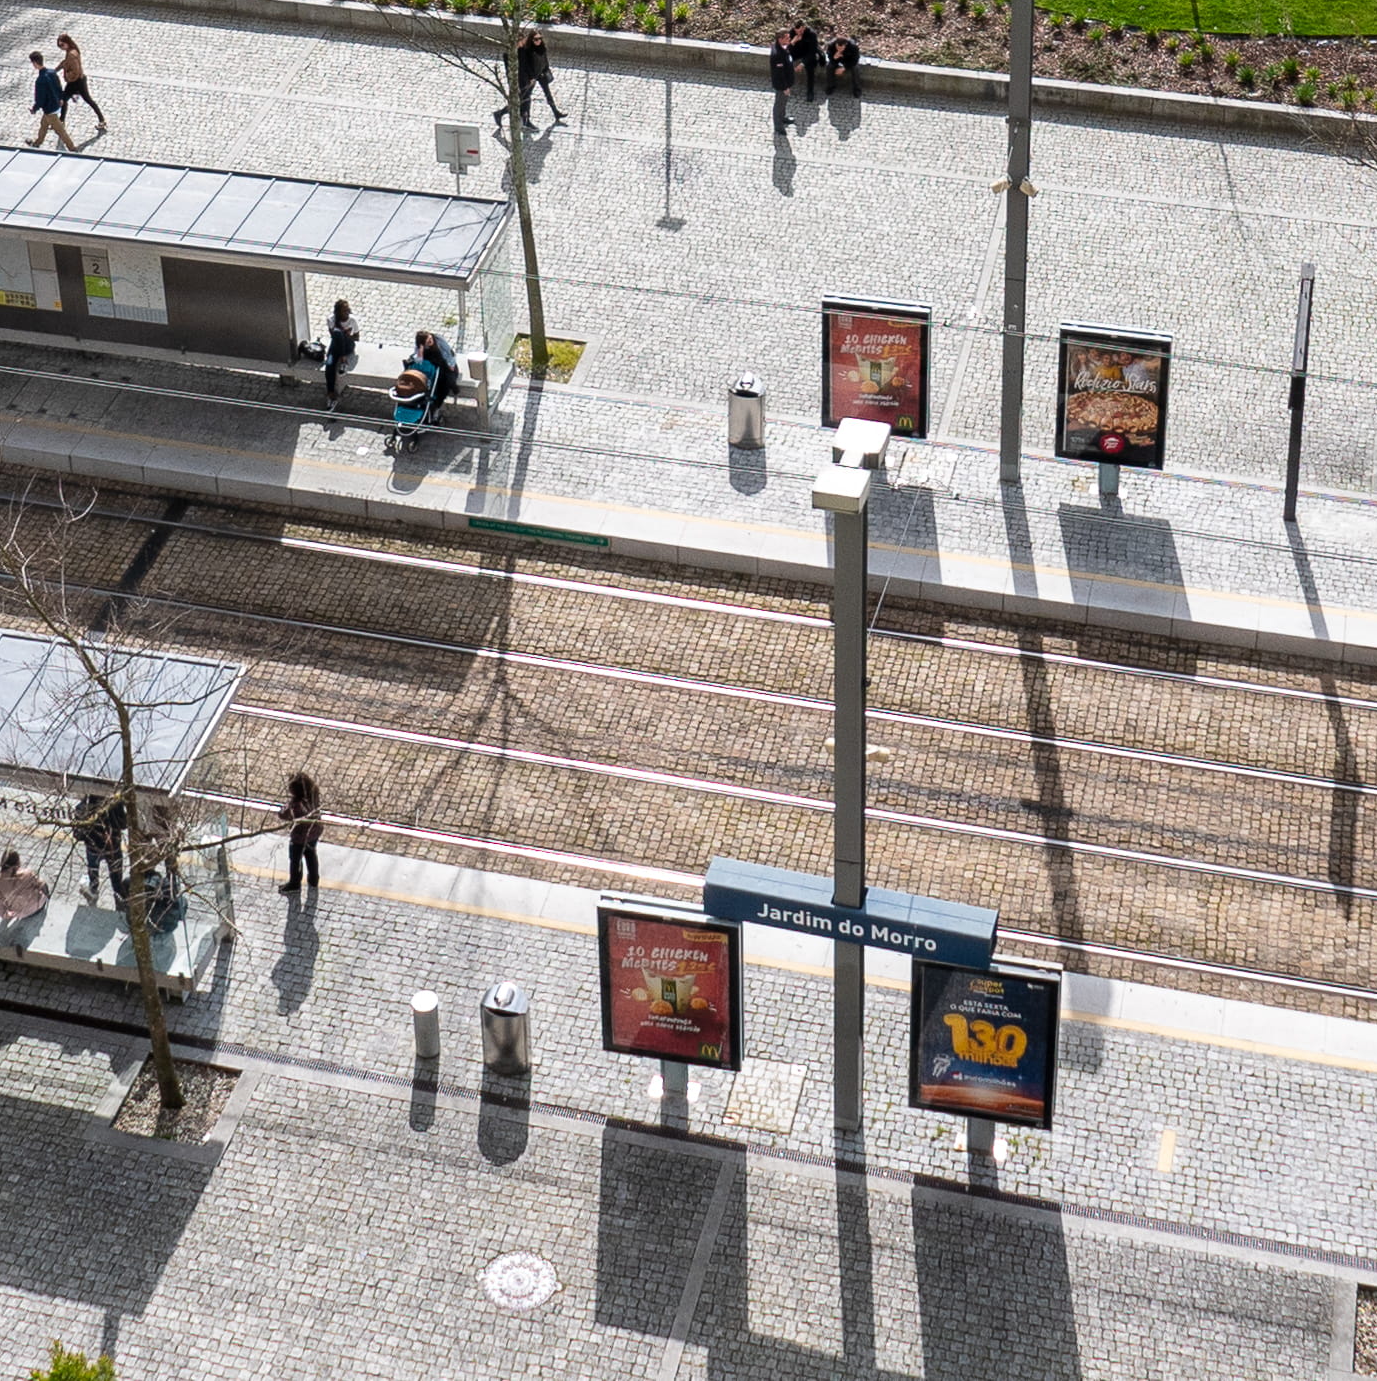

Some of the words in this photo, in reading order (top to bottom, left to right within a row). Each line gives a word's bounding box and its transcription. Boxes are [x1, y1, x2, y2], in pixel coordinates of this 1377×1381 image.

[757, 902, 834, 932] Jardim
[838, 917, 866, 938] do
[870, 922, 939, 953] Morro
[627, 945, 645, 958] 10
[650, 946, 710, 962] CHICKEN
[949, 1003, 956, 1011] O
[958, 1005, 976, 1013] QUE
[977, 1007, 1000, 1017] FARIA
[963, 999, 983, 1008] ESTA
[984, 1002, 1009, 1011] SEXTA
[943, 1013, 1028, 1060] 130
